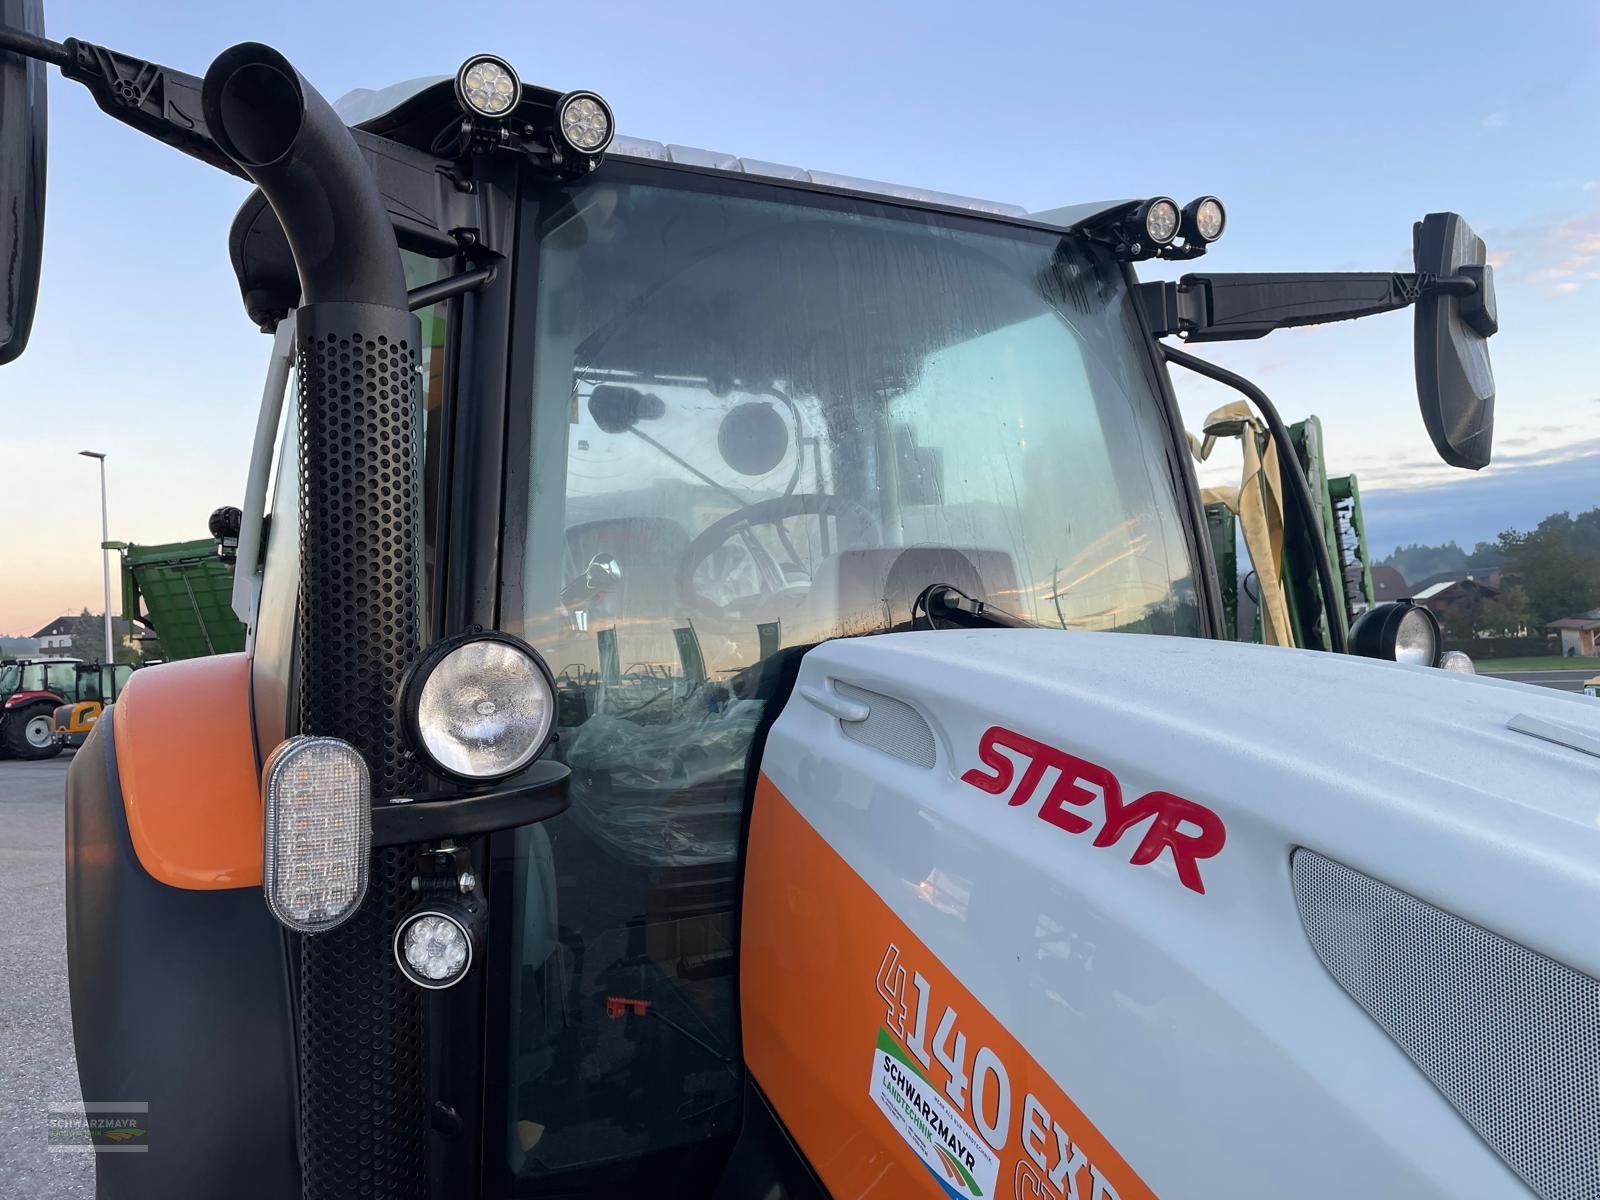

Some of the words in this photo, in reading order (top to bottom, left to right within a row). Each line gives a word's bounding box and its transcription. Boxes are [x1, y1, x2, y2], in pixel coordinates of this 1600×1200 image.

[960, 726, 1226, 895] STEYR
[876, 943, 1011, 1150] 4140
[882, 1076, 933, 1143] LANDTECHNIK
[883, 1055, 975, 1174] SCHWARZMAYR
